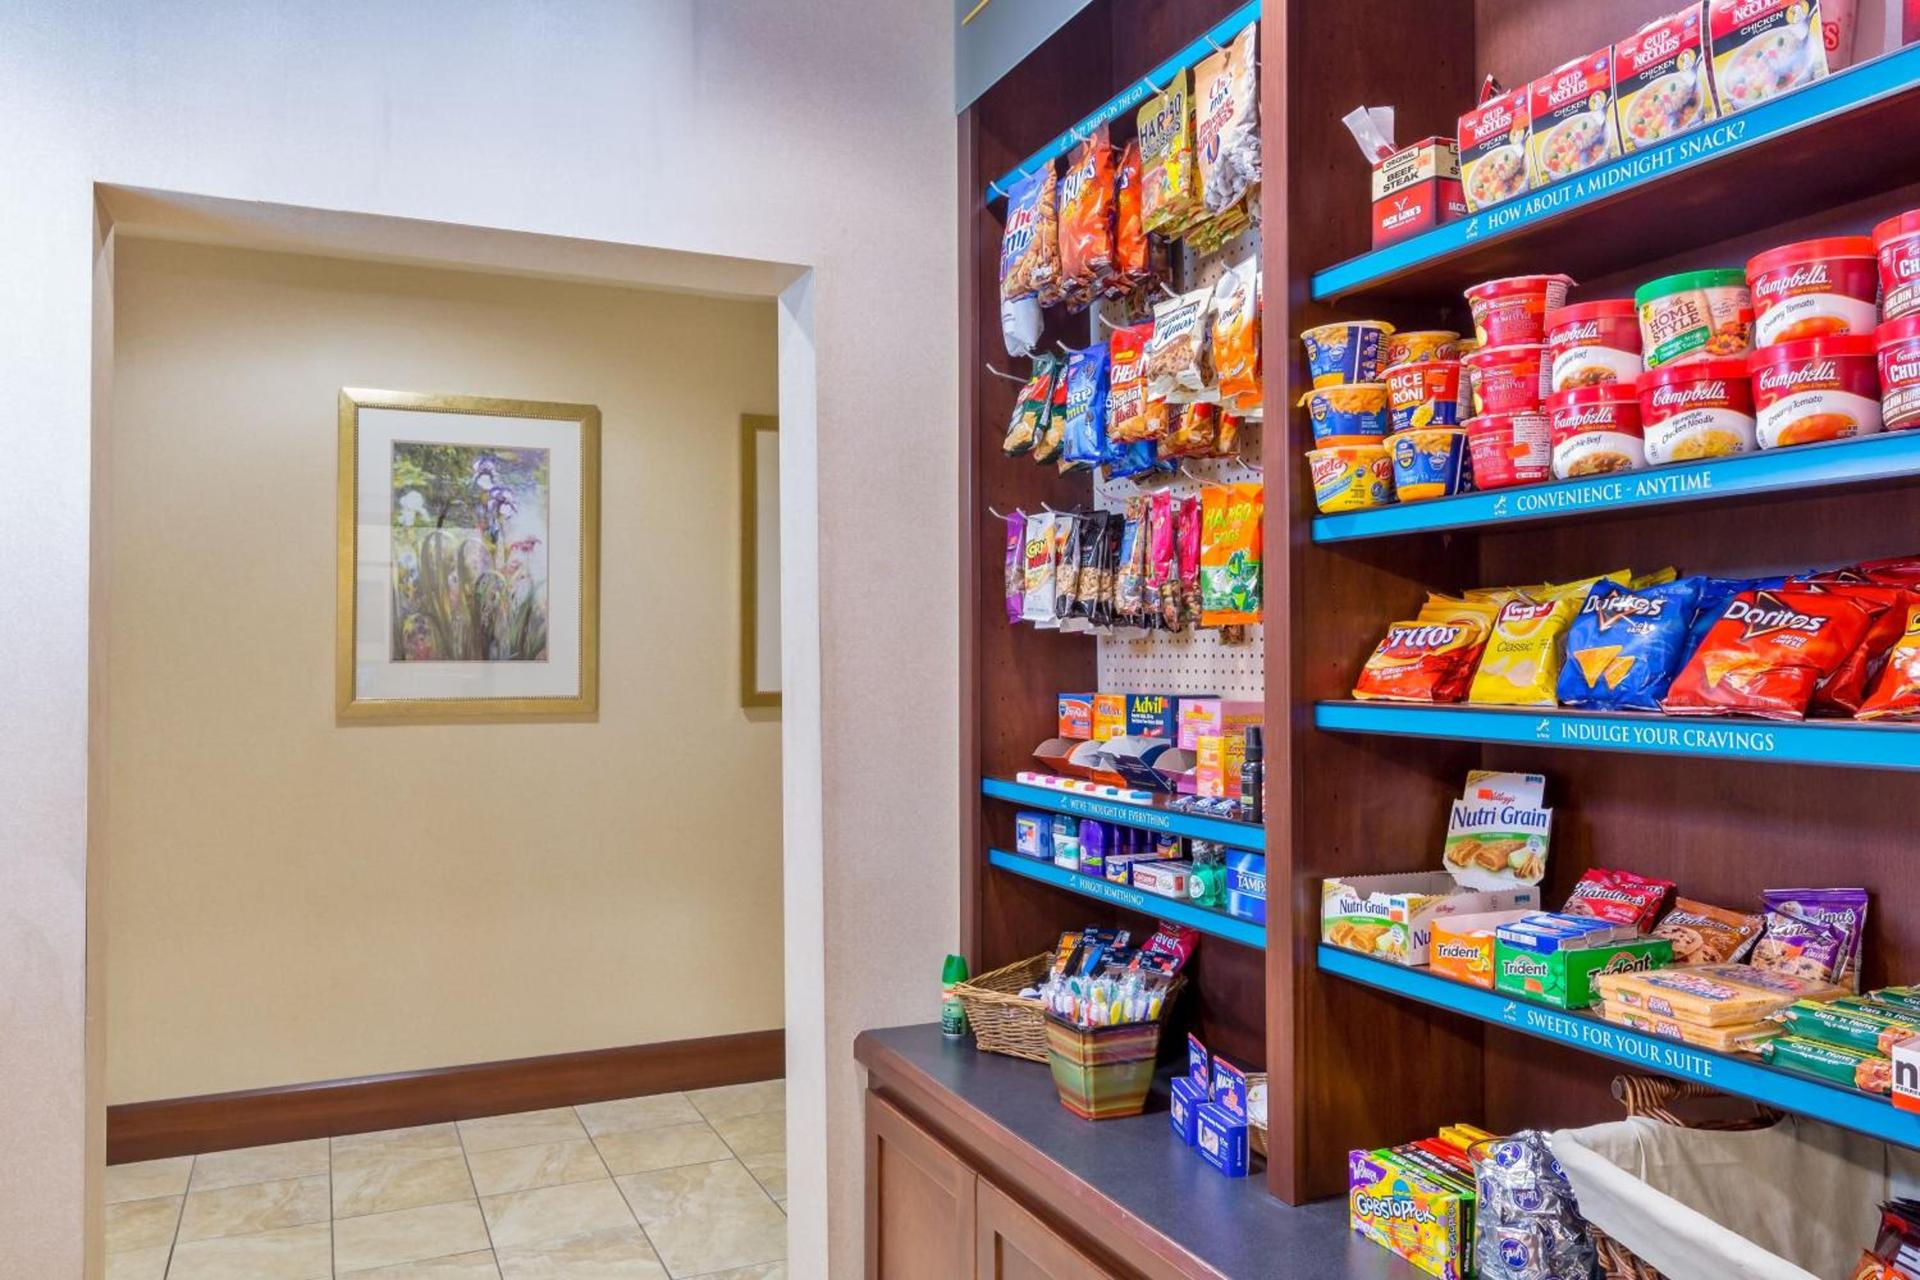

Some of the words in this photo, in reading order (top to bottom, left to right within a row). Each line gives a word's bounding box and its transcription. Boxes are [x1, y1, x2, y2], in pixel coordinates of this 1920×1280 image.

[1740, 11, 1784, 36] CHICKEN
[1643, 28, 1671, 50] CUP
[1633, 33, 1682, 70] NOODLES
[1558, 70, 1583, 88] CUP
[1640, 58, 1675, 80] CHICKEN
[1482, 106, 1505, 125] CUP
[1554, 98, 1587, 117] CHICKEN
[1383, 171, 1420, 193] STEAK
[1387, 164, 1415, 182] BEEF
[1488, 206, 1524, 230] HOW
[1524, 185, 1572, 215] ABOUT
[1574, 182, 1585, 199] A
[1587, 148, 1676, 194] MIDNIGHT
[1679, 120, 1746, 160] SNACK?
[1756, 265, 1829, 298] Campbell's
[1649, 301, 1697, 333] HOME
[1653, 311, 1701, 344] STYLE
[1390, 371, 1423, 391] RICE
[1760, 361, 1837, 391] Campbell's
[1392, 387, 1424, 405] RONI
[1652, 381, 1727, 408] Campbell's
[1793, 395, 1823, 409] Tomato
[1553, 405, 1613, 430] Campbell's
[1517, 483, 1622, 512] CONVENIENCE
[1635, 471, 1712, 498] ANYTIME
[1723, 601, 1827, 631] Doritos
[1131, 695, 1163, 714] Advil
[1561, 723, 1630, 743] INDULGE
[1633, 726, 1681, 746] YOUR
[1684, 730, 1775, 751] CRAVINGS
[1087, 801, 1118, 817] THOUGHT
[1118, 807, 1127, 819] OF
[1128, 809, 1170, 829] EVERYTHING
[1451, 806, 1497, 830] Nutri
[1501, 806, 1547, 828] Grain
[1340, 899, 1363, 915] Nutri
[1364, 900, 1390, 916] Grain
[1437, 944, 1479, 958] Trident
[1503, 961, 1548, 976] Trident
[1848, 1018, 1879, 1034] Honey
[1527, 1010, 1579, 1038] SWEETS
[1583, 1025, 1613, 1049] FOR
[1616, 1035, 1661, 1063] YOUR
[1664, 1049, 1713, 1078] SUITE
